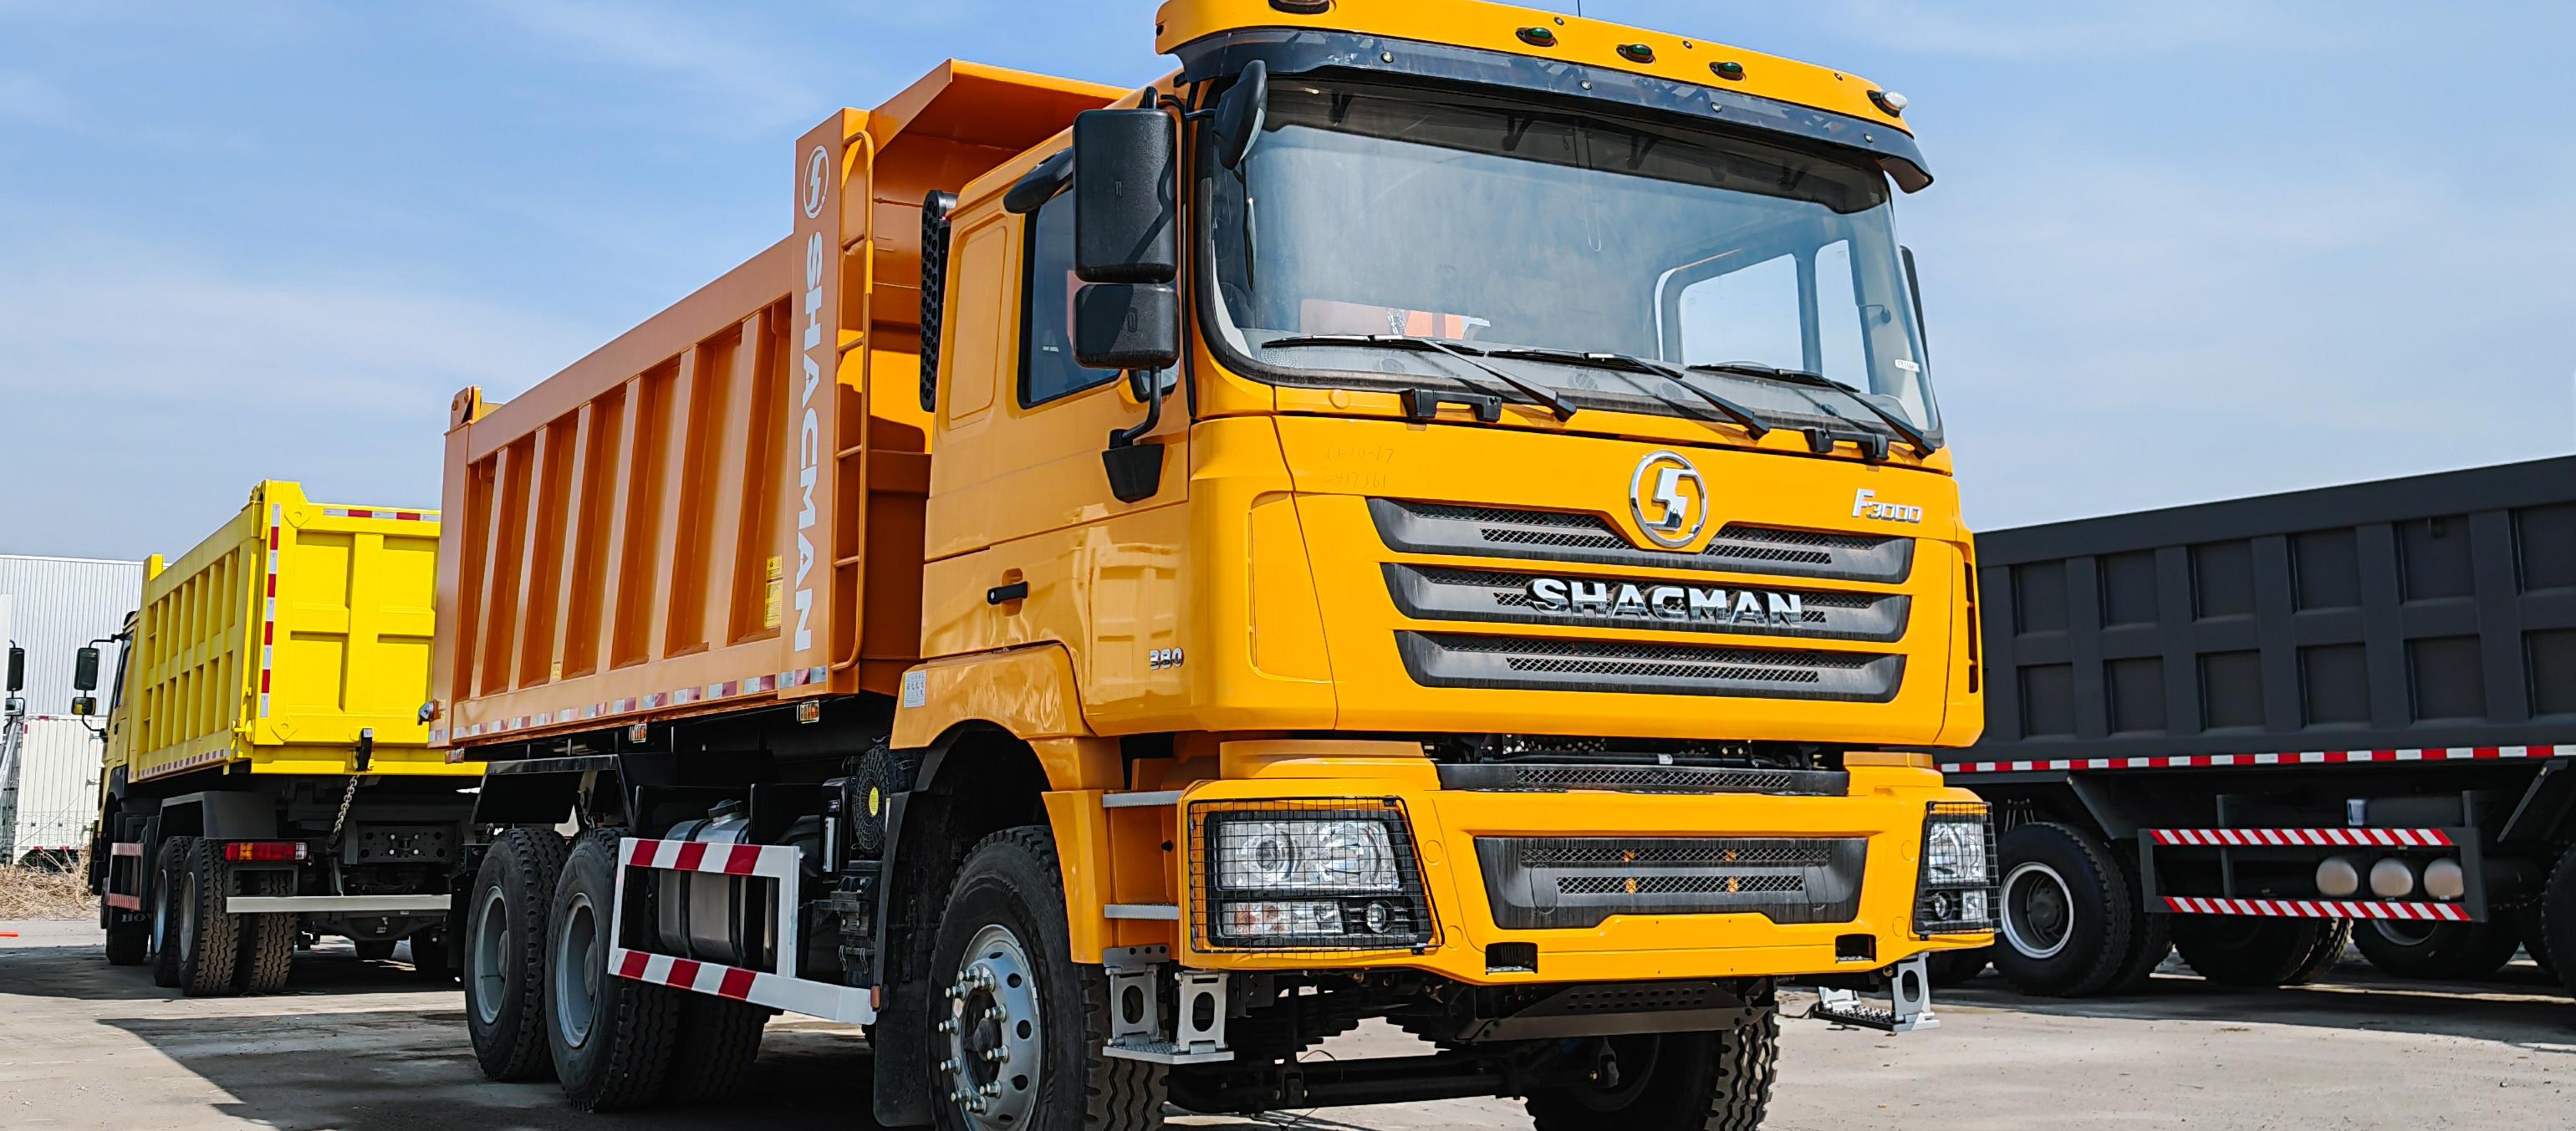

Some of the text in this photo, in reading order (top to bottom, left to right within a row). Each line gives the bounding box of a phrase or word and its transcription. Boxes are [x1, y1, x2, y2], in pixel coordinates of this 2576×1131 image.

[795, 231, 823, 653] SHACMAN
[1852, 488, 1922, 523] F3000
[1528, 578, 1802, 627] SHACMAN
[1150, 647, 1184, 670] 380
